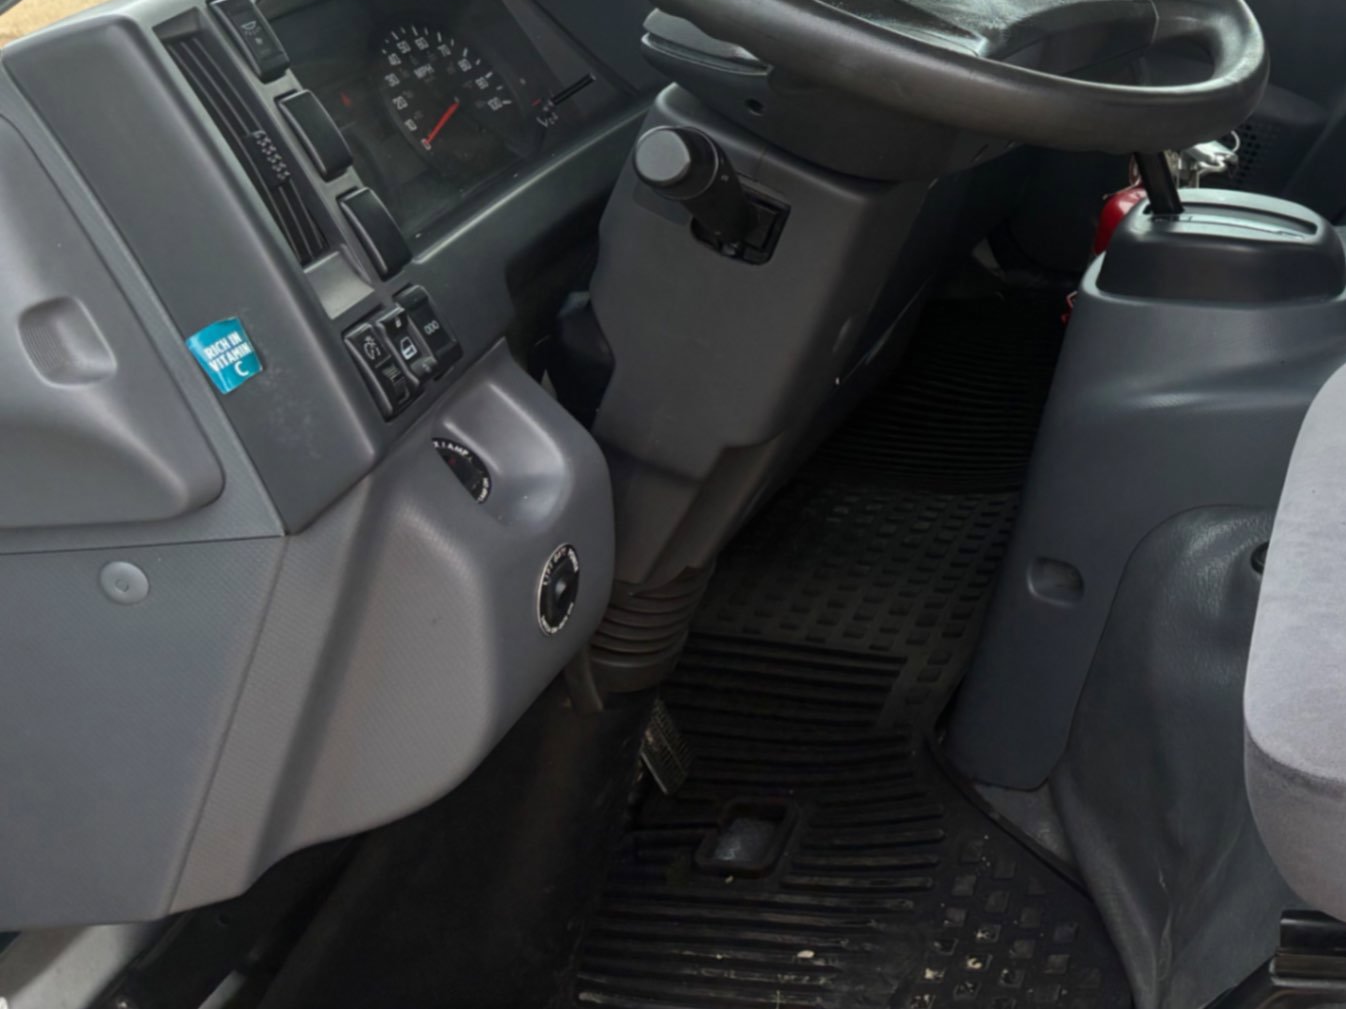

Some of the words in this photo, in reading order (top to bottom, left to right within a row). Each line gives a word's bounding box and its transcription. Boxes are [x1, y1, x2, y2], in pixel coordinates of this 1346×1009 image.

[203, 337, 232, 361] RICH
[226, 330, 243, 346] IN
[208, 341, 252, 372] VITAMIN
[234, 360, 249, 376] C
